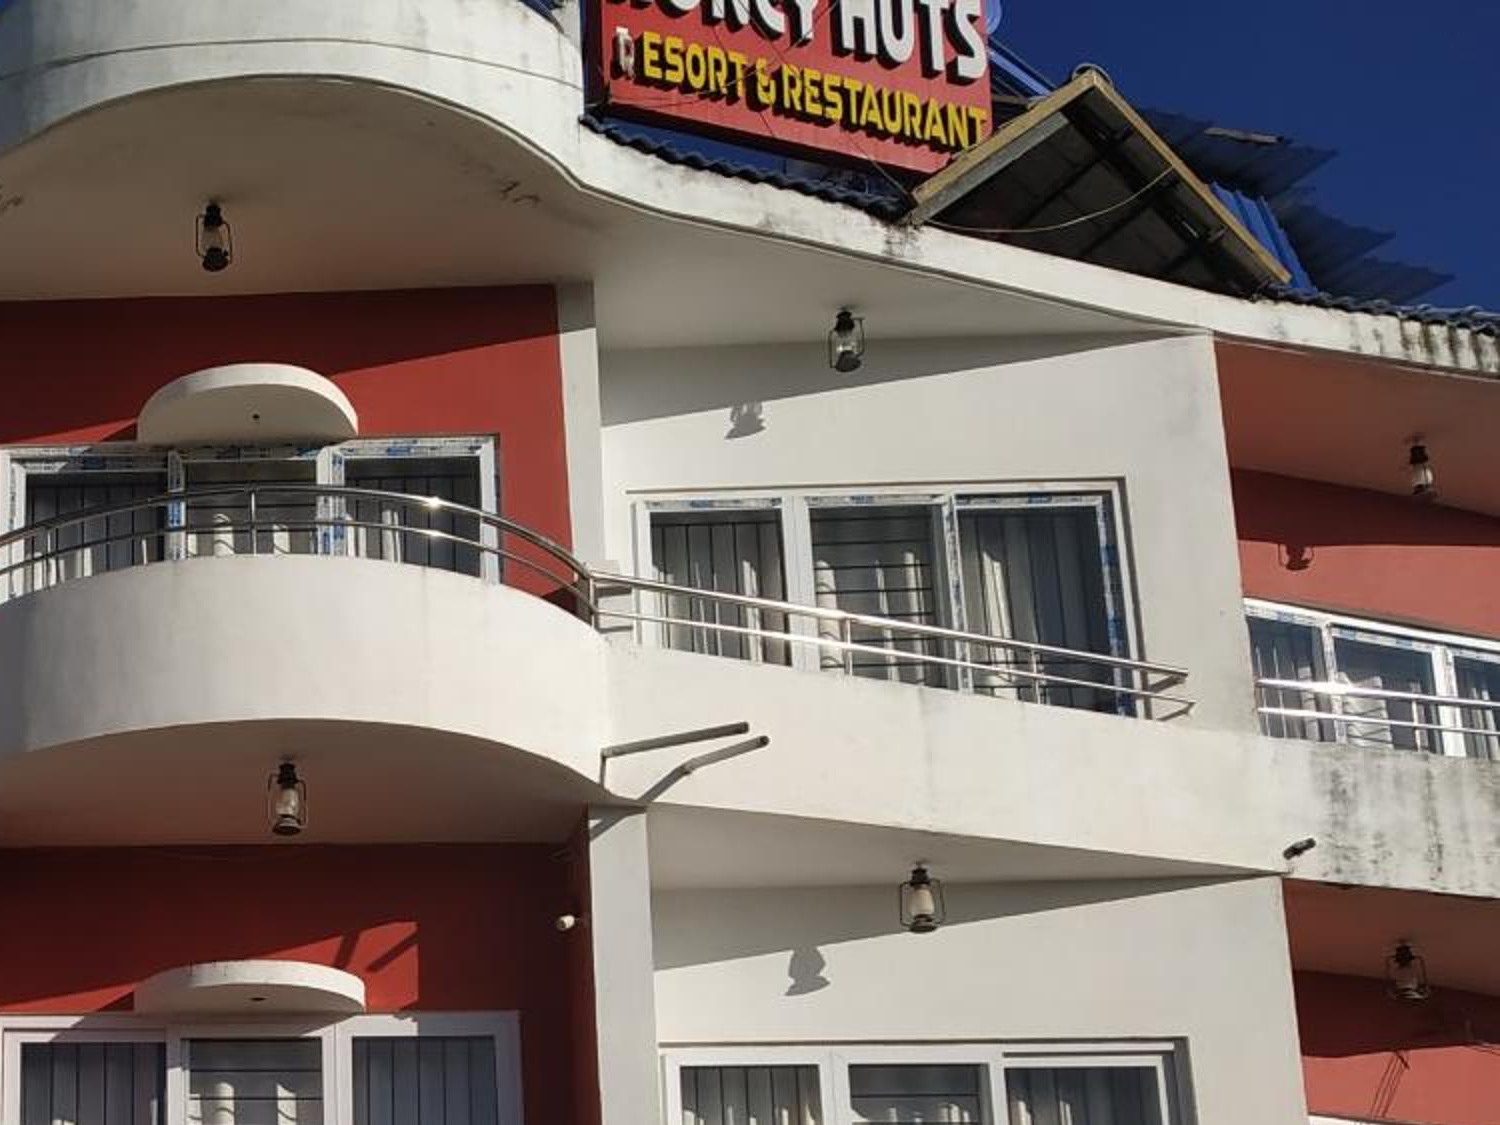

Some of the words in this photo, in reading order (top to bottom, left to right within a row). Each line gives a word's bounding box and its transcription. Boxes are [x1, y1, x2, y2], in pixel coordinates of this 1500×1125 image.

[838, 0, 987, 79] HUTS
[755, 57, 776, 104] &
[781, 63, 987, 150] RESTAURANT
